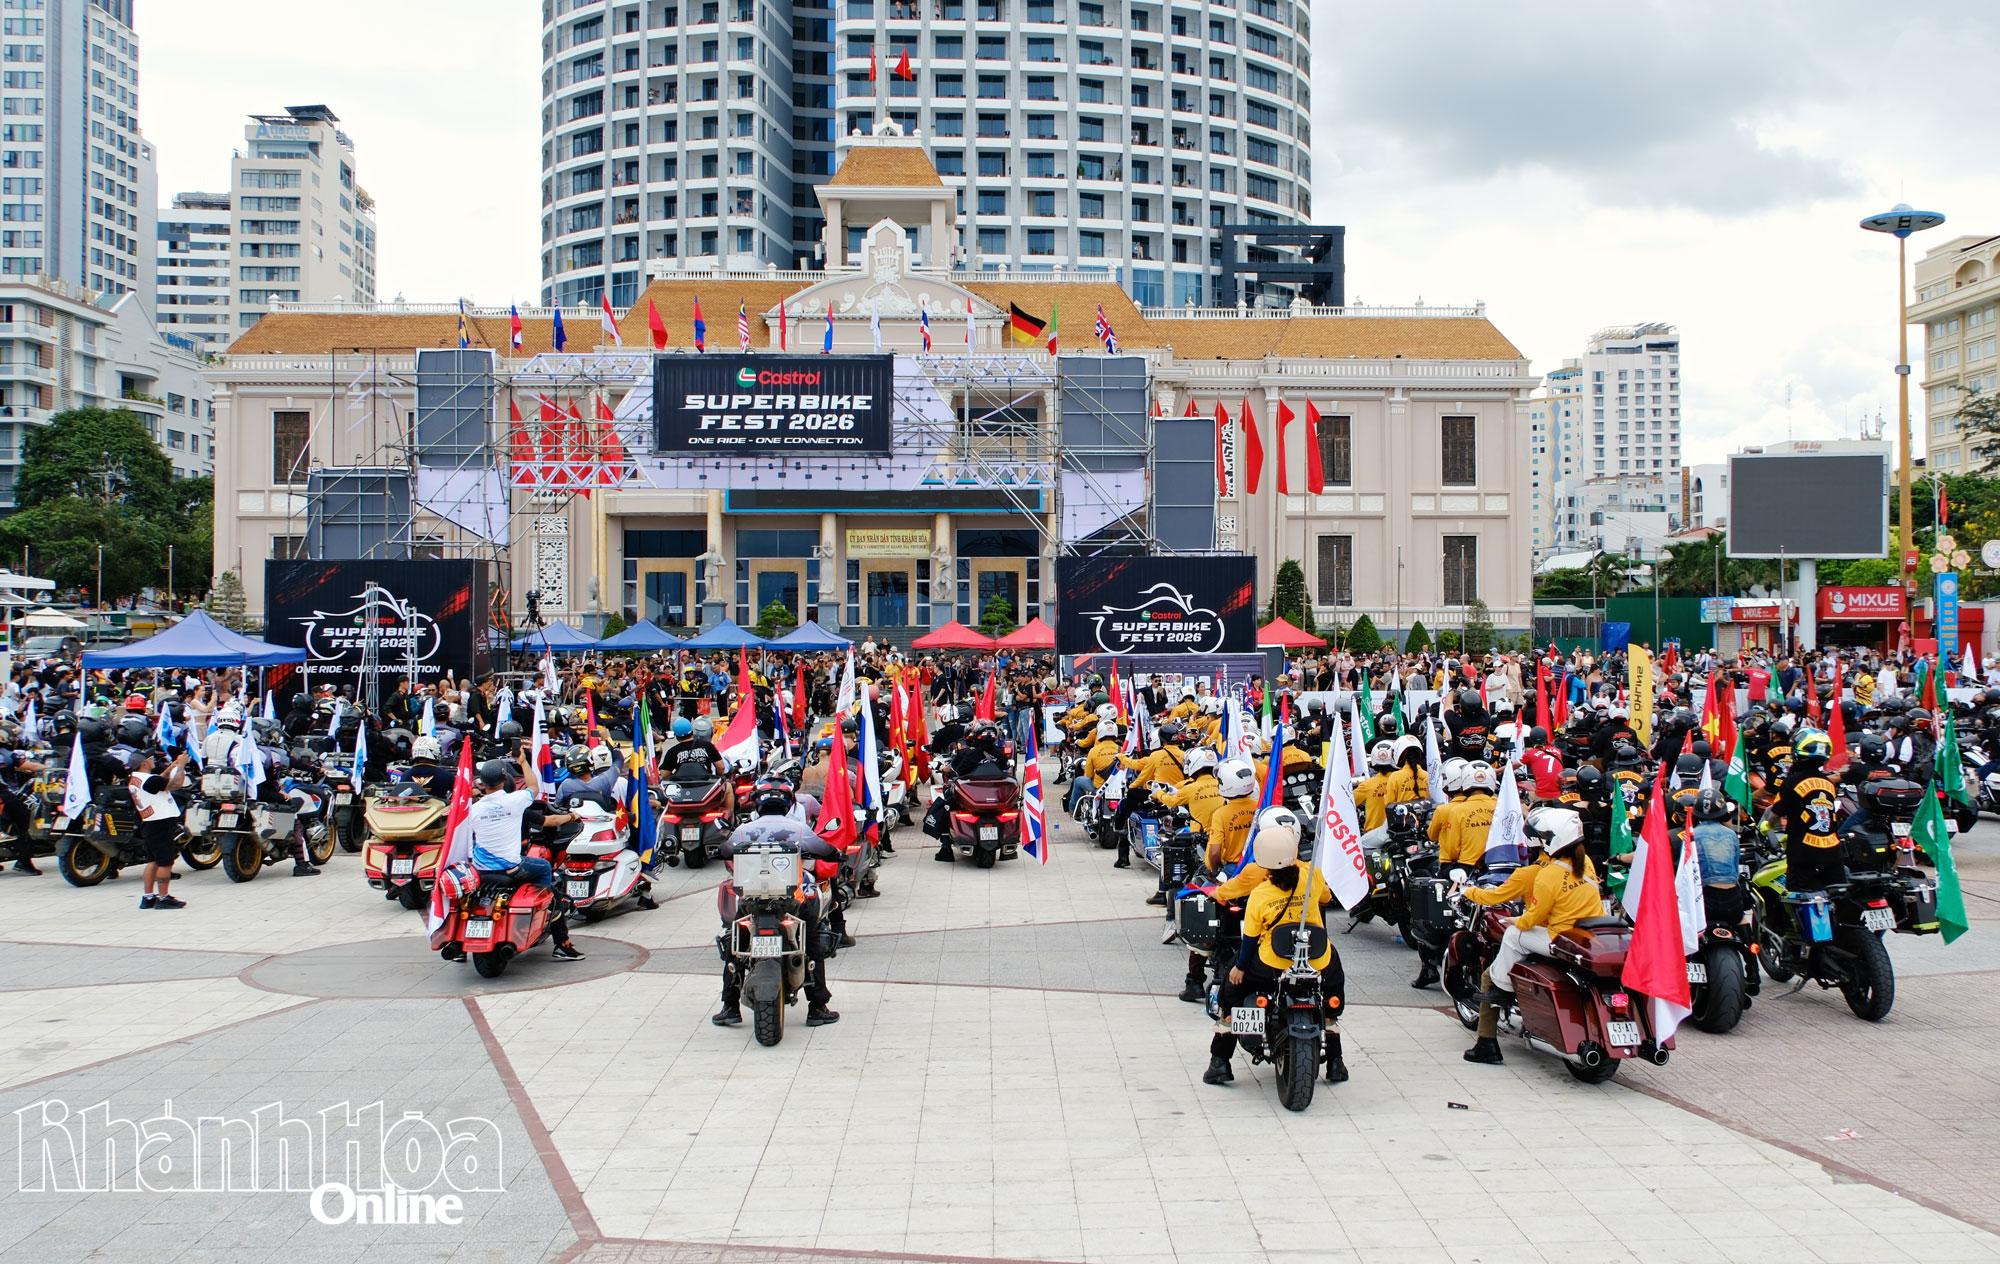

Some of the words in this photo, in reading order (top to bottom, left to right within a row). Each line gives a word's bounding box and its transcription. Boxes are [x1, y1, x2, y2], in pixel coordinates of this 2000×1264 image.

[758, 370, 821, 385] Castrol
[678, 394, 872, 410] SUPERBIKE
[696, 414, 784, 430] FEST
[790, 413, 855, 430] 2026
[1849, 593, 1900, 606] MIXUE
[1151, 611, 1182, 620] Castrol
[1109, 622, 1212, 632] SUPERBIKE
[331, 638, 378, 648] FEST
[1120, 633, 1165, 643] FEST
[1166, 632, 1202, 643] 2026
[295, 665, 317, 674] ONE
[318, 665, 343, 673] RIDE
[1542, 753, 1555, 774] 7
[1236, 1009, 1260, 1020] 43-A1
[1232, 1021, 1264, 1033] 002.48
[1612, 1023, 1634, 1033] 43-A1
